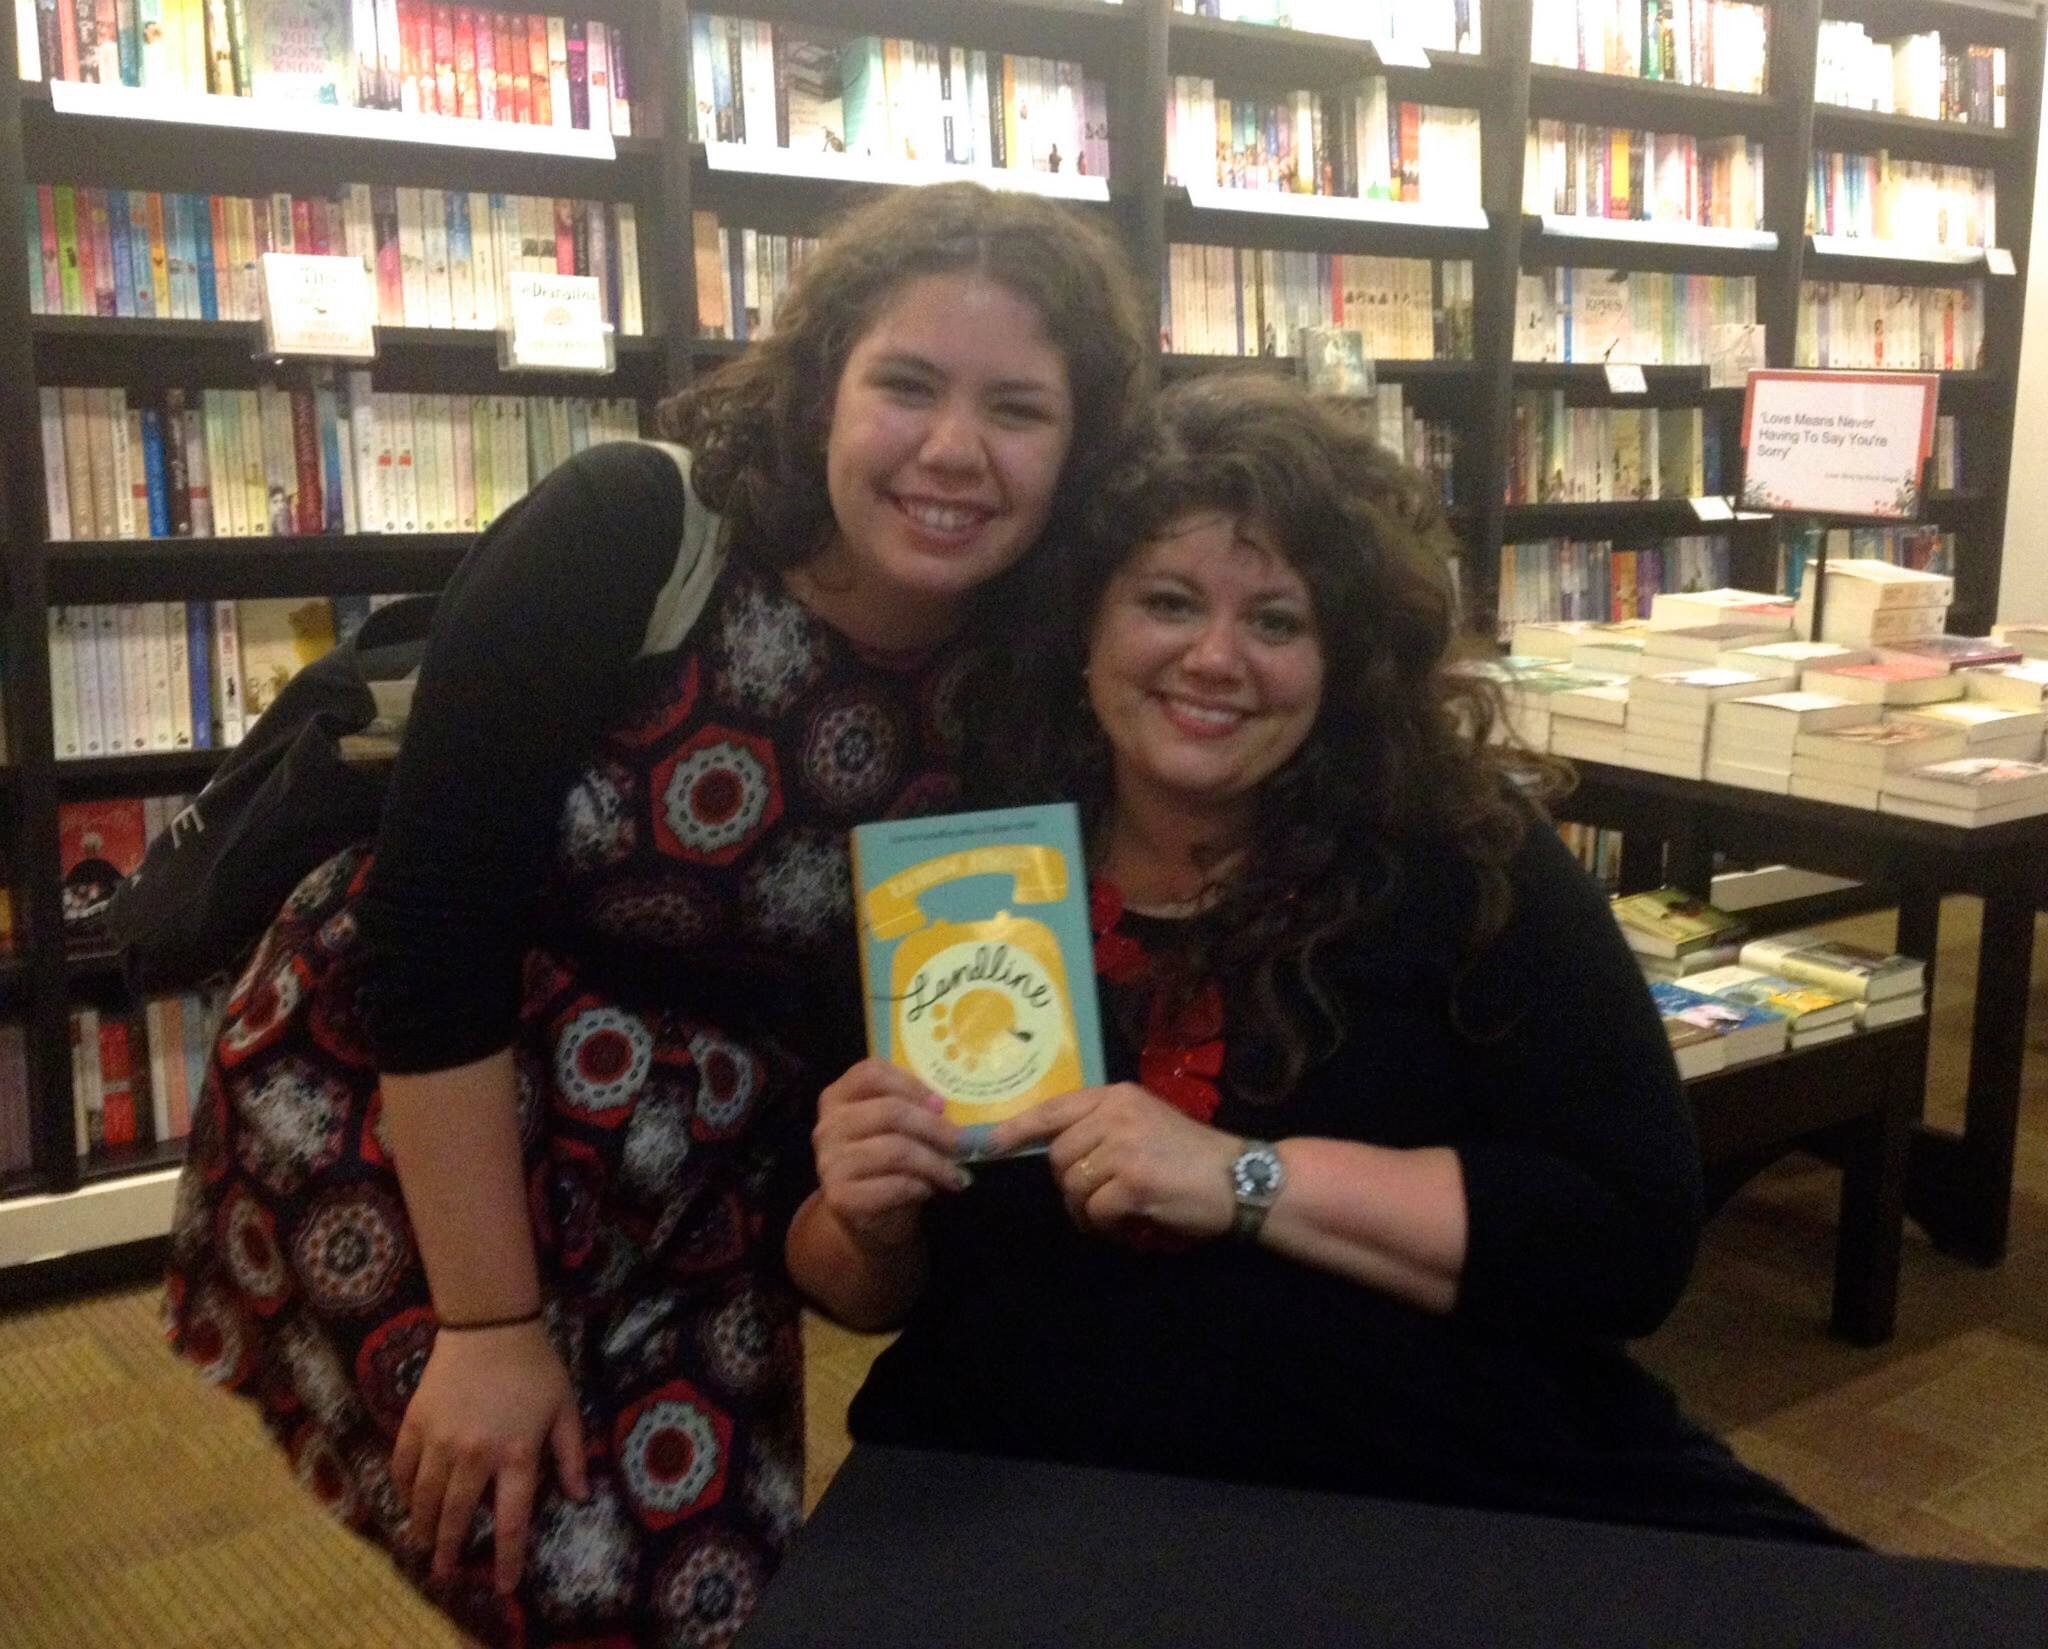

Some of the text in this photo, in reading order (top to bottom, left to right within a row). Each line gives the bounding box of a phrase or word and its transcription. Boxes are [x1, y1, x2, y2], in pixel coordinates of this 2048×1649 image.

[1794, 414, 1834, 428] Means
[1838, 416, 1876, 429] Never
[1758, 429, 1888, 448] Having To Say You're
[906, 944, 1051, 1023] Landline
